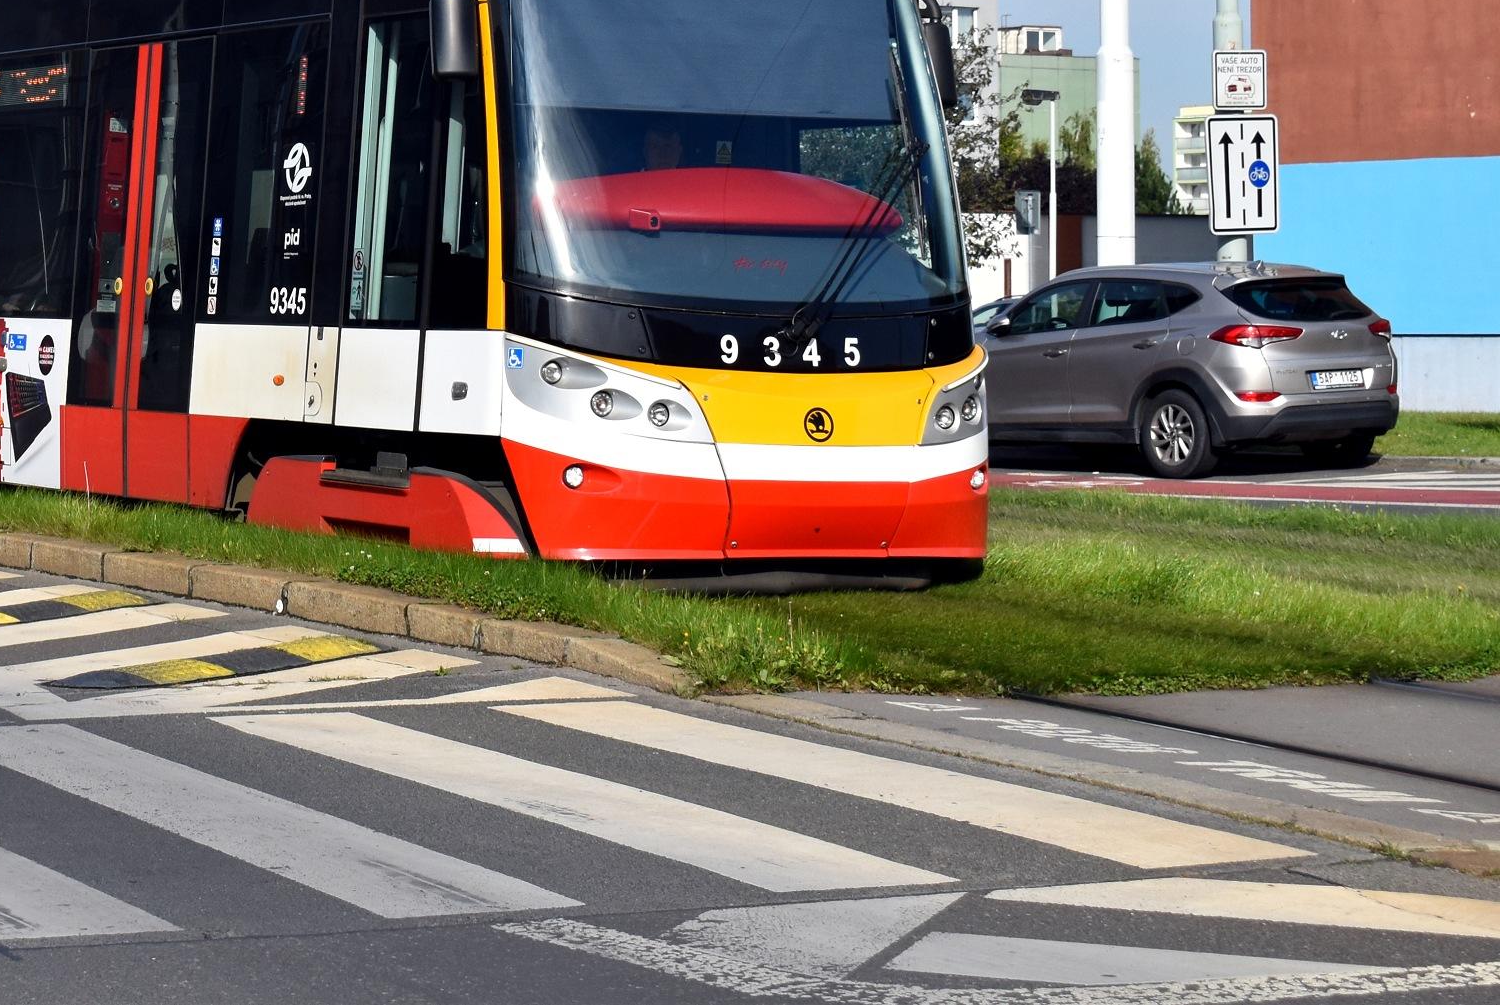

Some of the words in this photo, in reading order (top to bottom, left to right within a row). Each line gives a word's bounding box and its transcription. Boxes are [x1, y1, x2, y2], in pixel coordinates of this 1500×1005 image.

[1221, 56, 1238, 64] VAŠE
[1240, 57, 1259, 65] AUTO
[1236, 66, 1262, 74] TREZOR
[283, 227, 301, 250] pid
[269, 286, 307, 315] 9345
